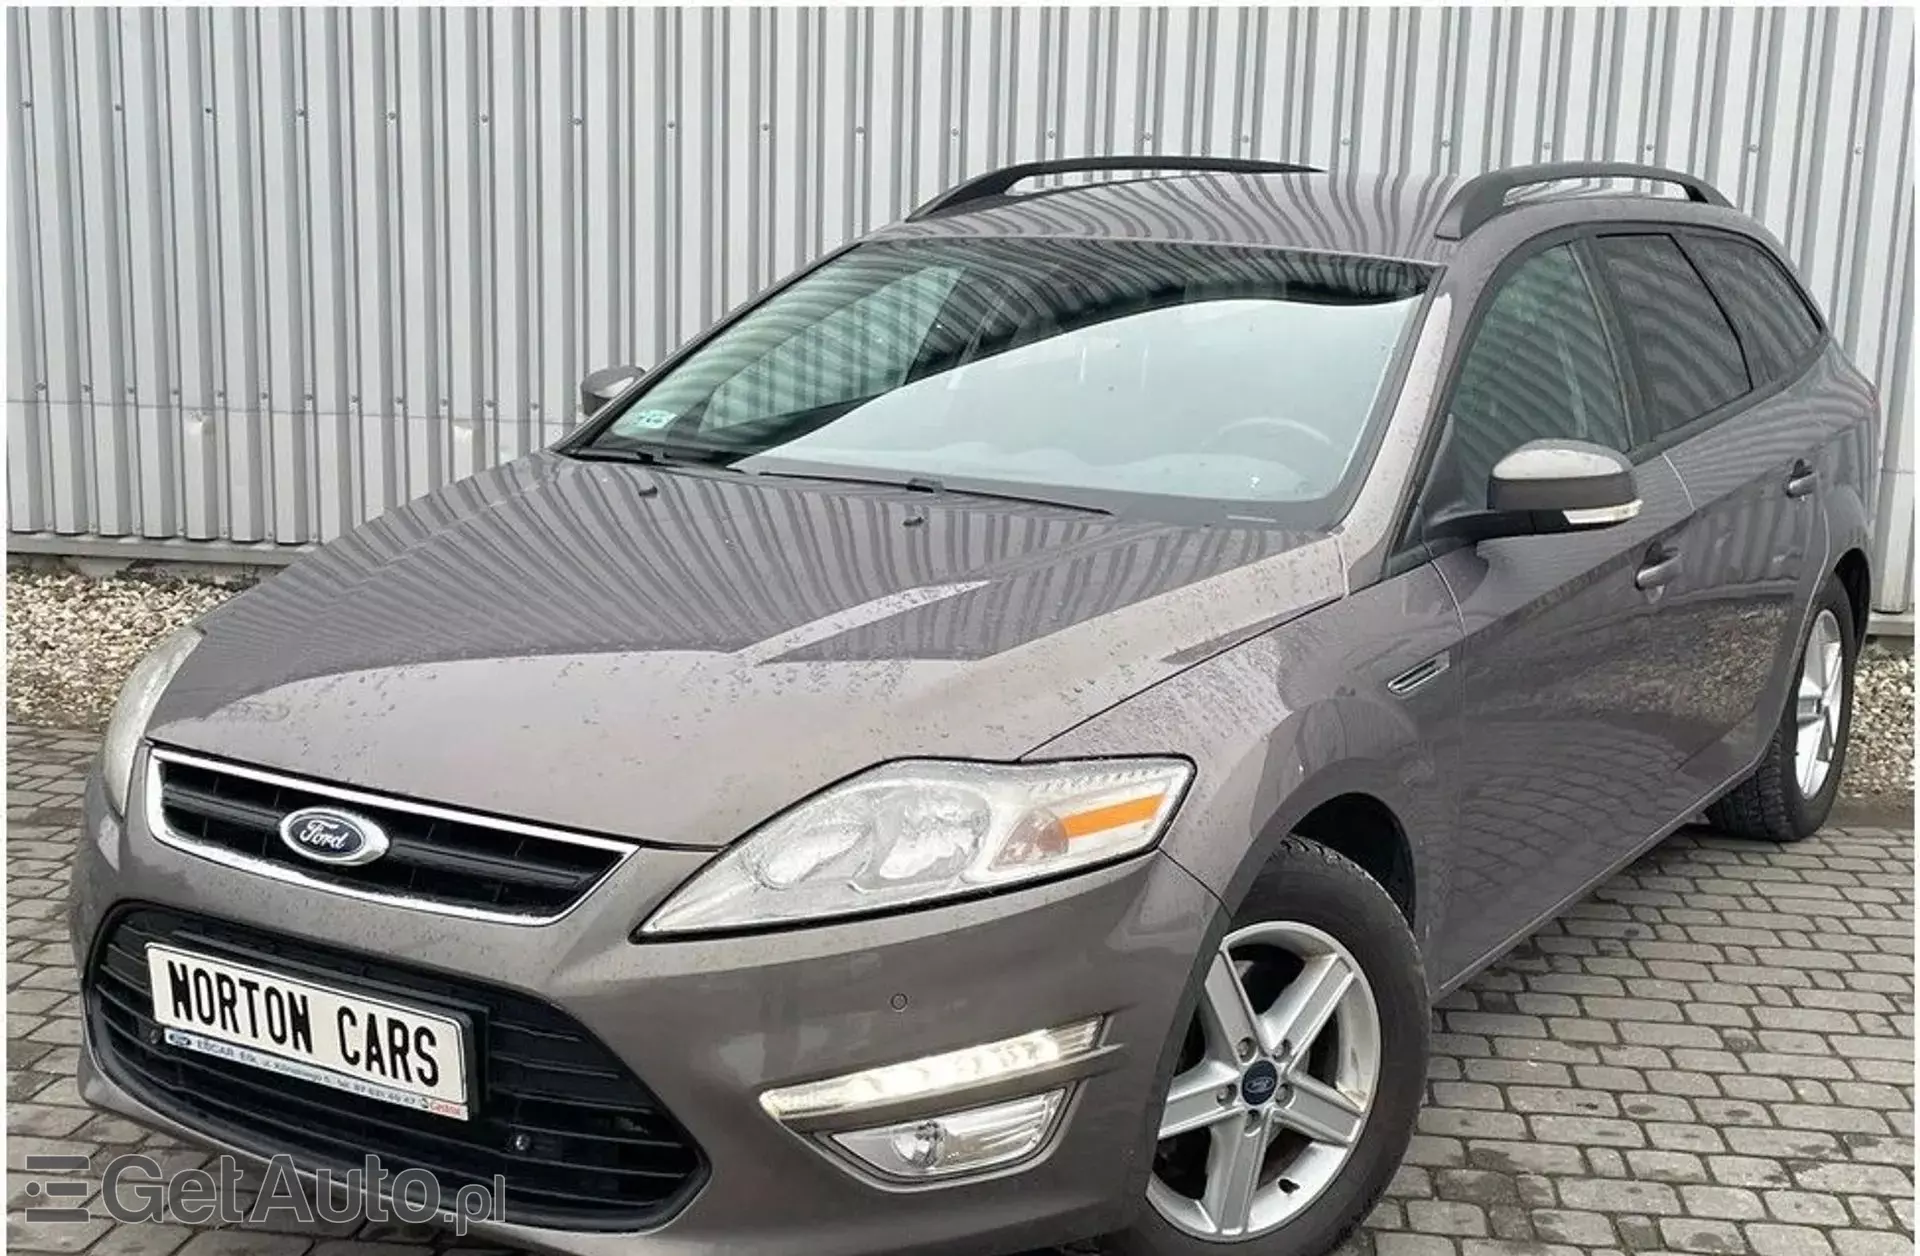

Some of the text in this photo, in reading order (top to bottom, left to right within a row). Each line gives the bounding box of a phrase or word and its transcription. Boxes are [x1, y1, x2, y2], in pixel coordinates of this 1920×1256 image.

[300, 820, 349, 849] Ford
[167, 960, 439, 1087] NORTON CARS
